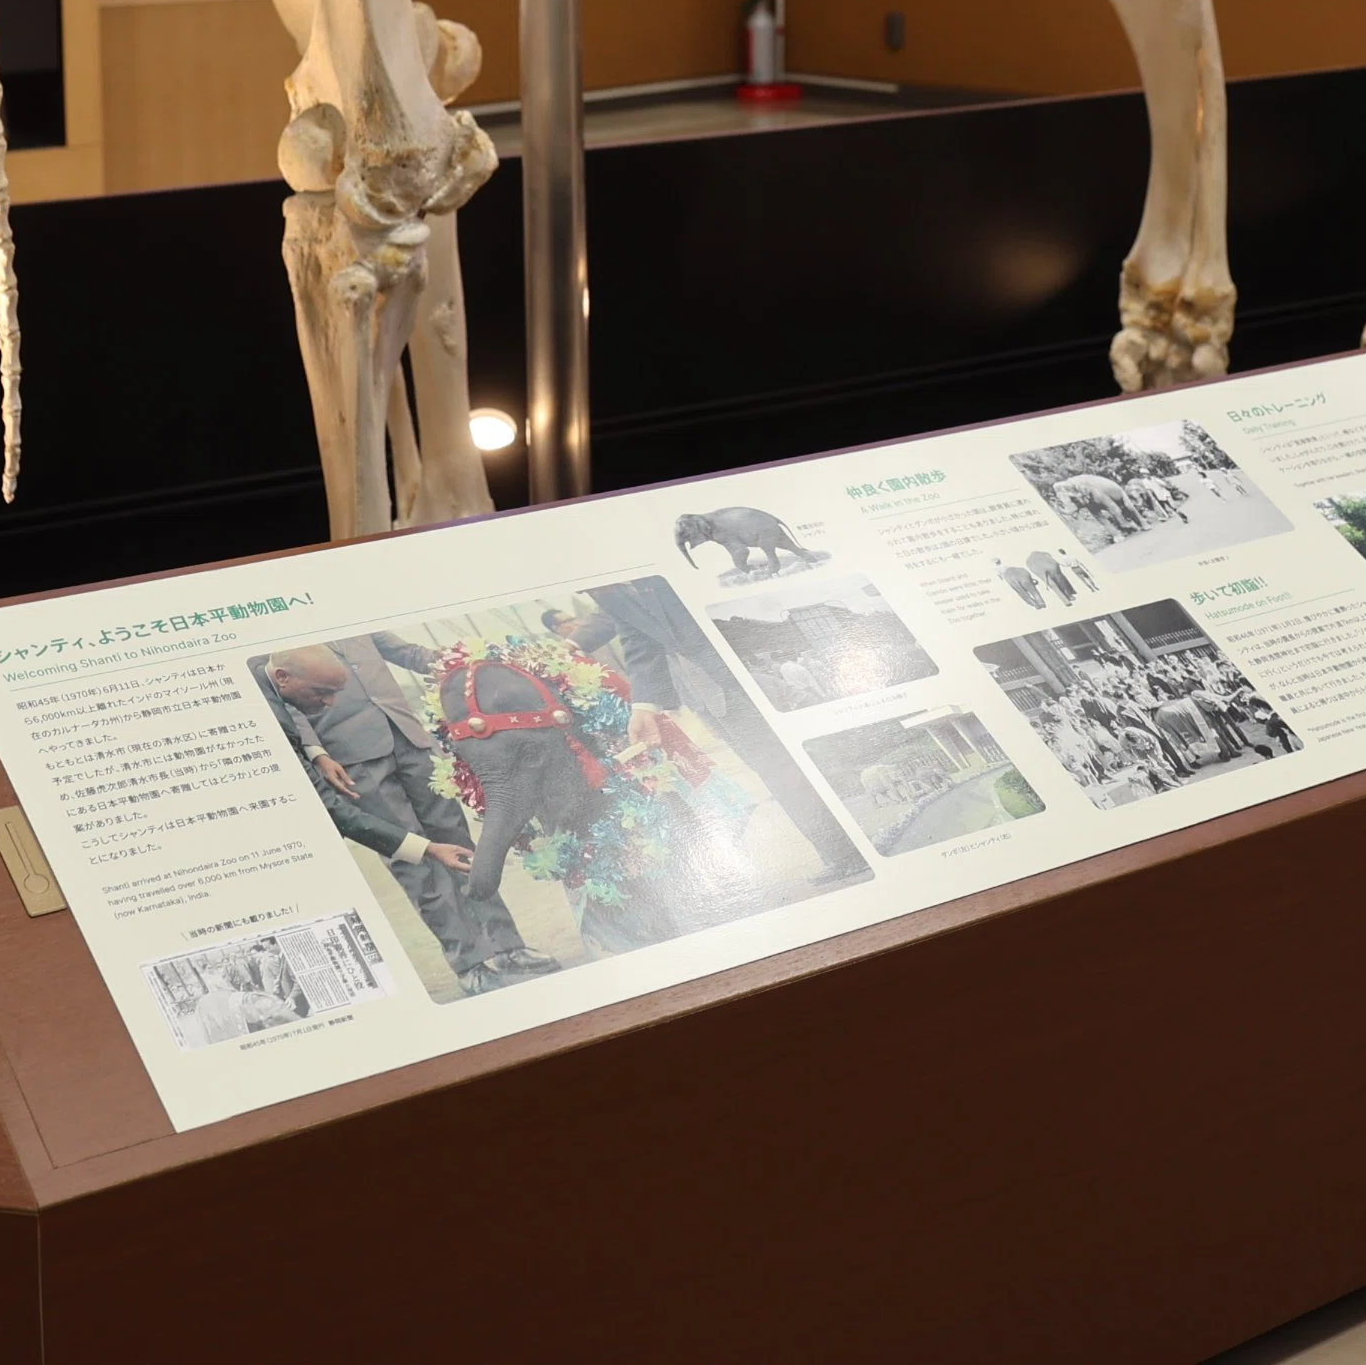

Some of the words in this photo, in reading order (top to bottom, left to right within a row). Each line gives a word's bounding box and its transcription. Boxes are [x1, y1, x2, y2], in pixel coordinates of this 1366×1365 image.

[1226, 392, 1326, 423] 日々のトレーニング
[846, 470, 946, 500] 仲良く園内散歩
[903, 497, 921, 505] the
[920, 493, 940, 501] Zoo
[1190, 576, 1268, 606] 歩いて初詣!!
[1204, 603, 1255, 620] Hatsumode
[3, 663, 78, 682] Welcoming
[79, 653, 122, 668] Shanti
[124, 651, 138, 660] to
[140, 638, 210, 657] Nihondaira
[211, 632, 237, 643] Zoo
[38, 734, 117, 754] へやってきました。
[73, 812, 147, 833] 案がありました。
[89, 844, 161, 865] とになりました。
[102, 881, 130, 894] Shanti
[131, 874, 162, 887] arrived
[173, 862, 219, 877] Nihondaira
[220, 858, 237, 866] Zoo
[263, 847, 282, 856] June
[282, 841, 305, 851] 1970,
[107, 895, 138, 906] having
[138, 884, 176, 899] travelled
[177, 880, 195, 890] over
[197, 874, 222, 885] 6,000
[223, 871, 237, 879] km
[238, 866, 258, 875] from
[259, 858, 290, 870] Mysore
[291, 853, 313, 862] State
[114, 909, 136, 920] (now
